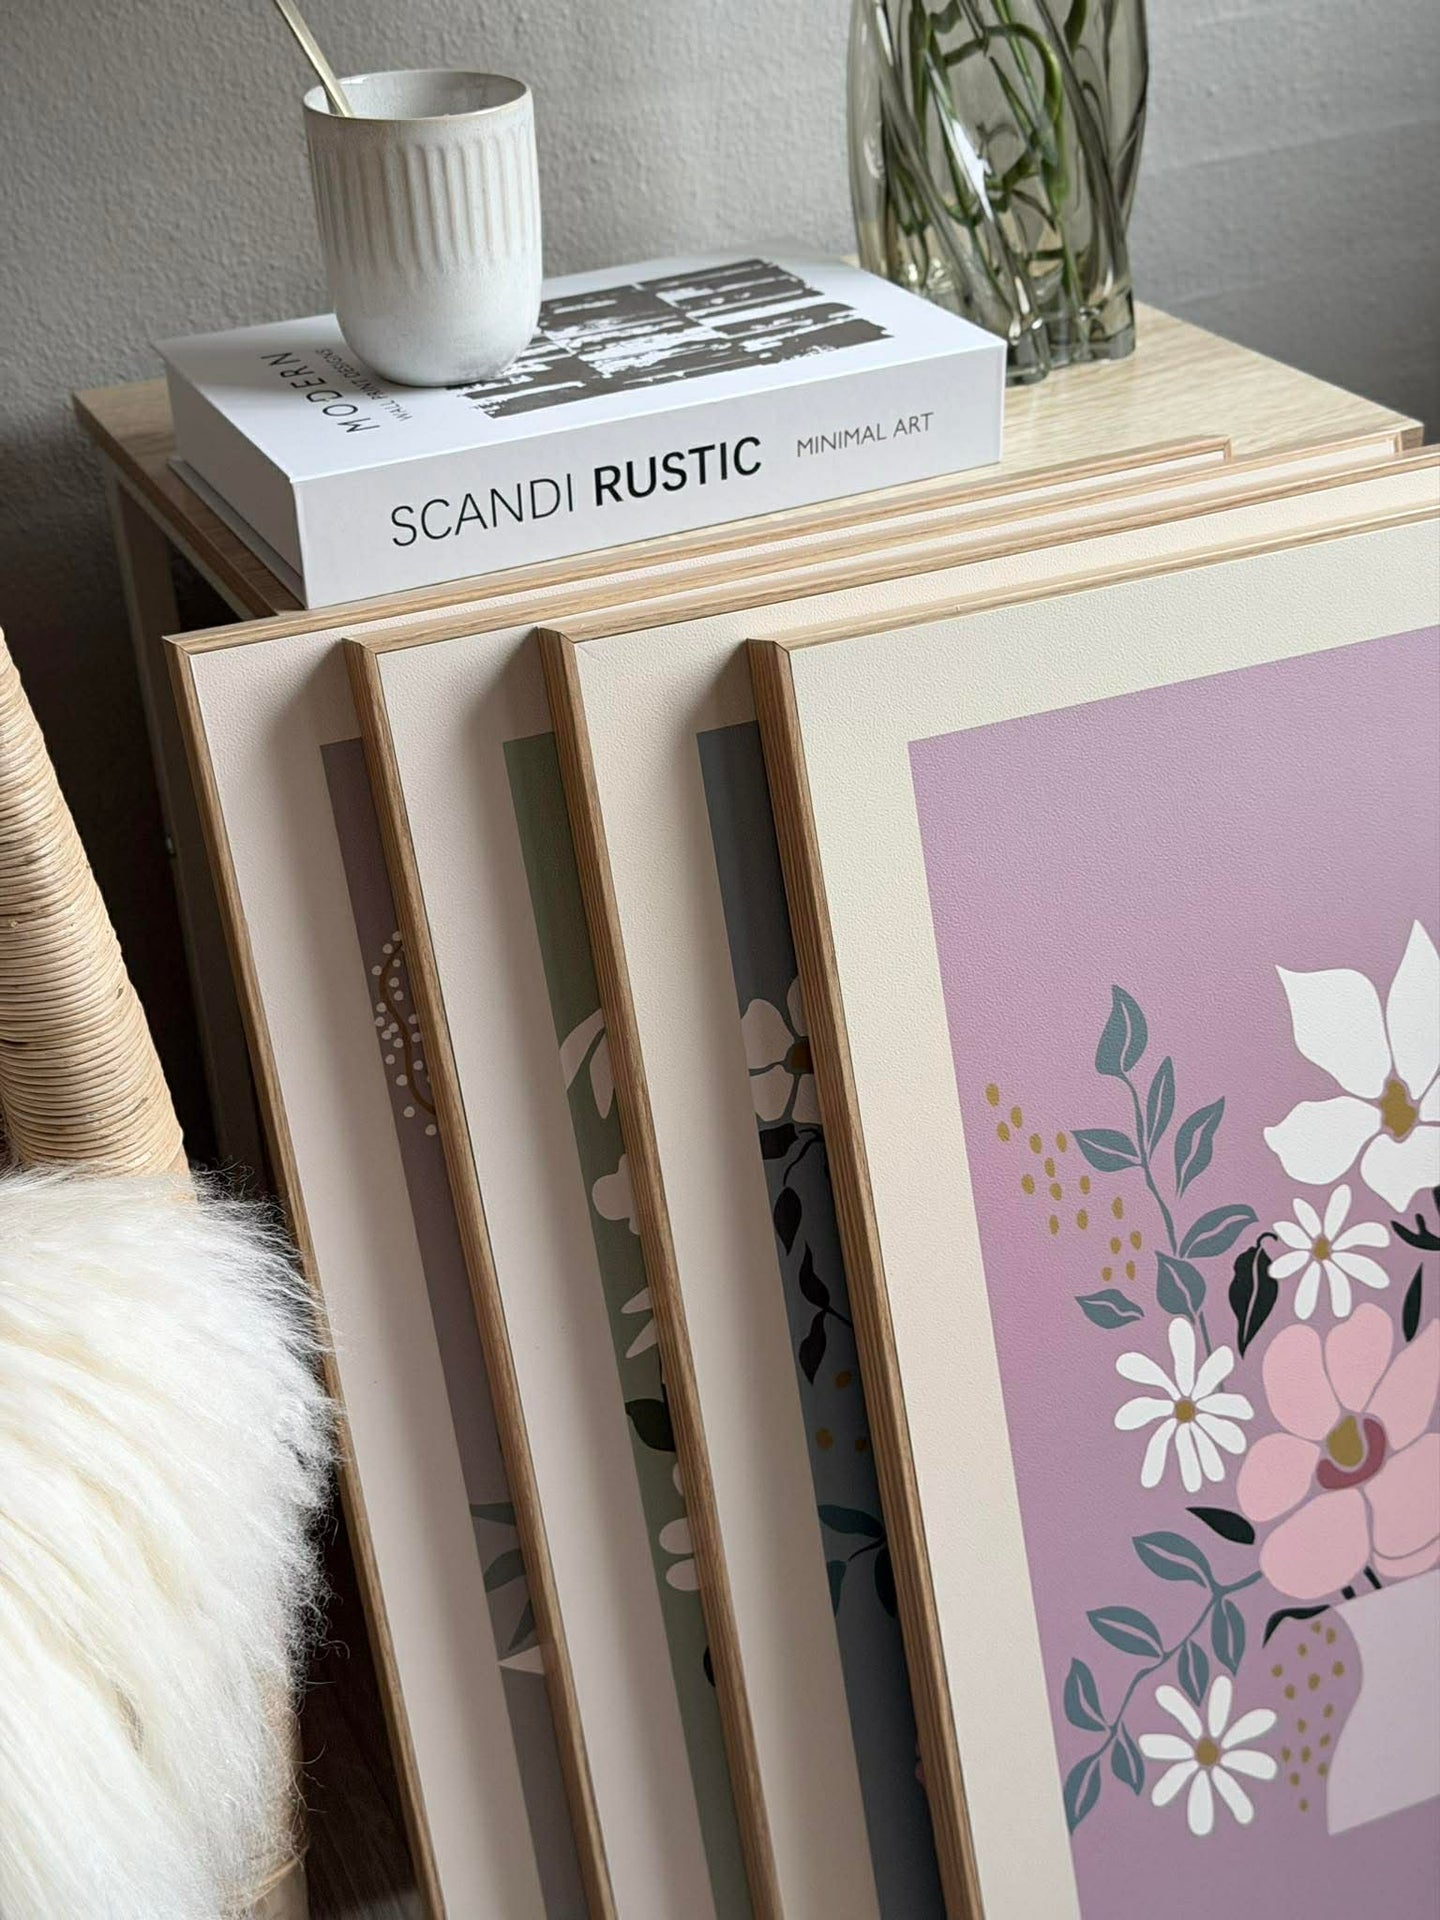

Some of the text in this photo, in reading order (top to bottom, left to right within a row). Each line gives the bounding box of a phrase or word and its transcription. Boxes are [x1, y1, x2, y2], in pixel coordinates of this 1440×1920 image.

[260, 352, 380, 433] MODERN
[352, 379, 389, 400] PRINT
[380, 400, 414, 422] WALL
[391, 412, 934, 547] SCANDI RUSTIC MINIMAL ART
